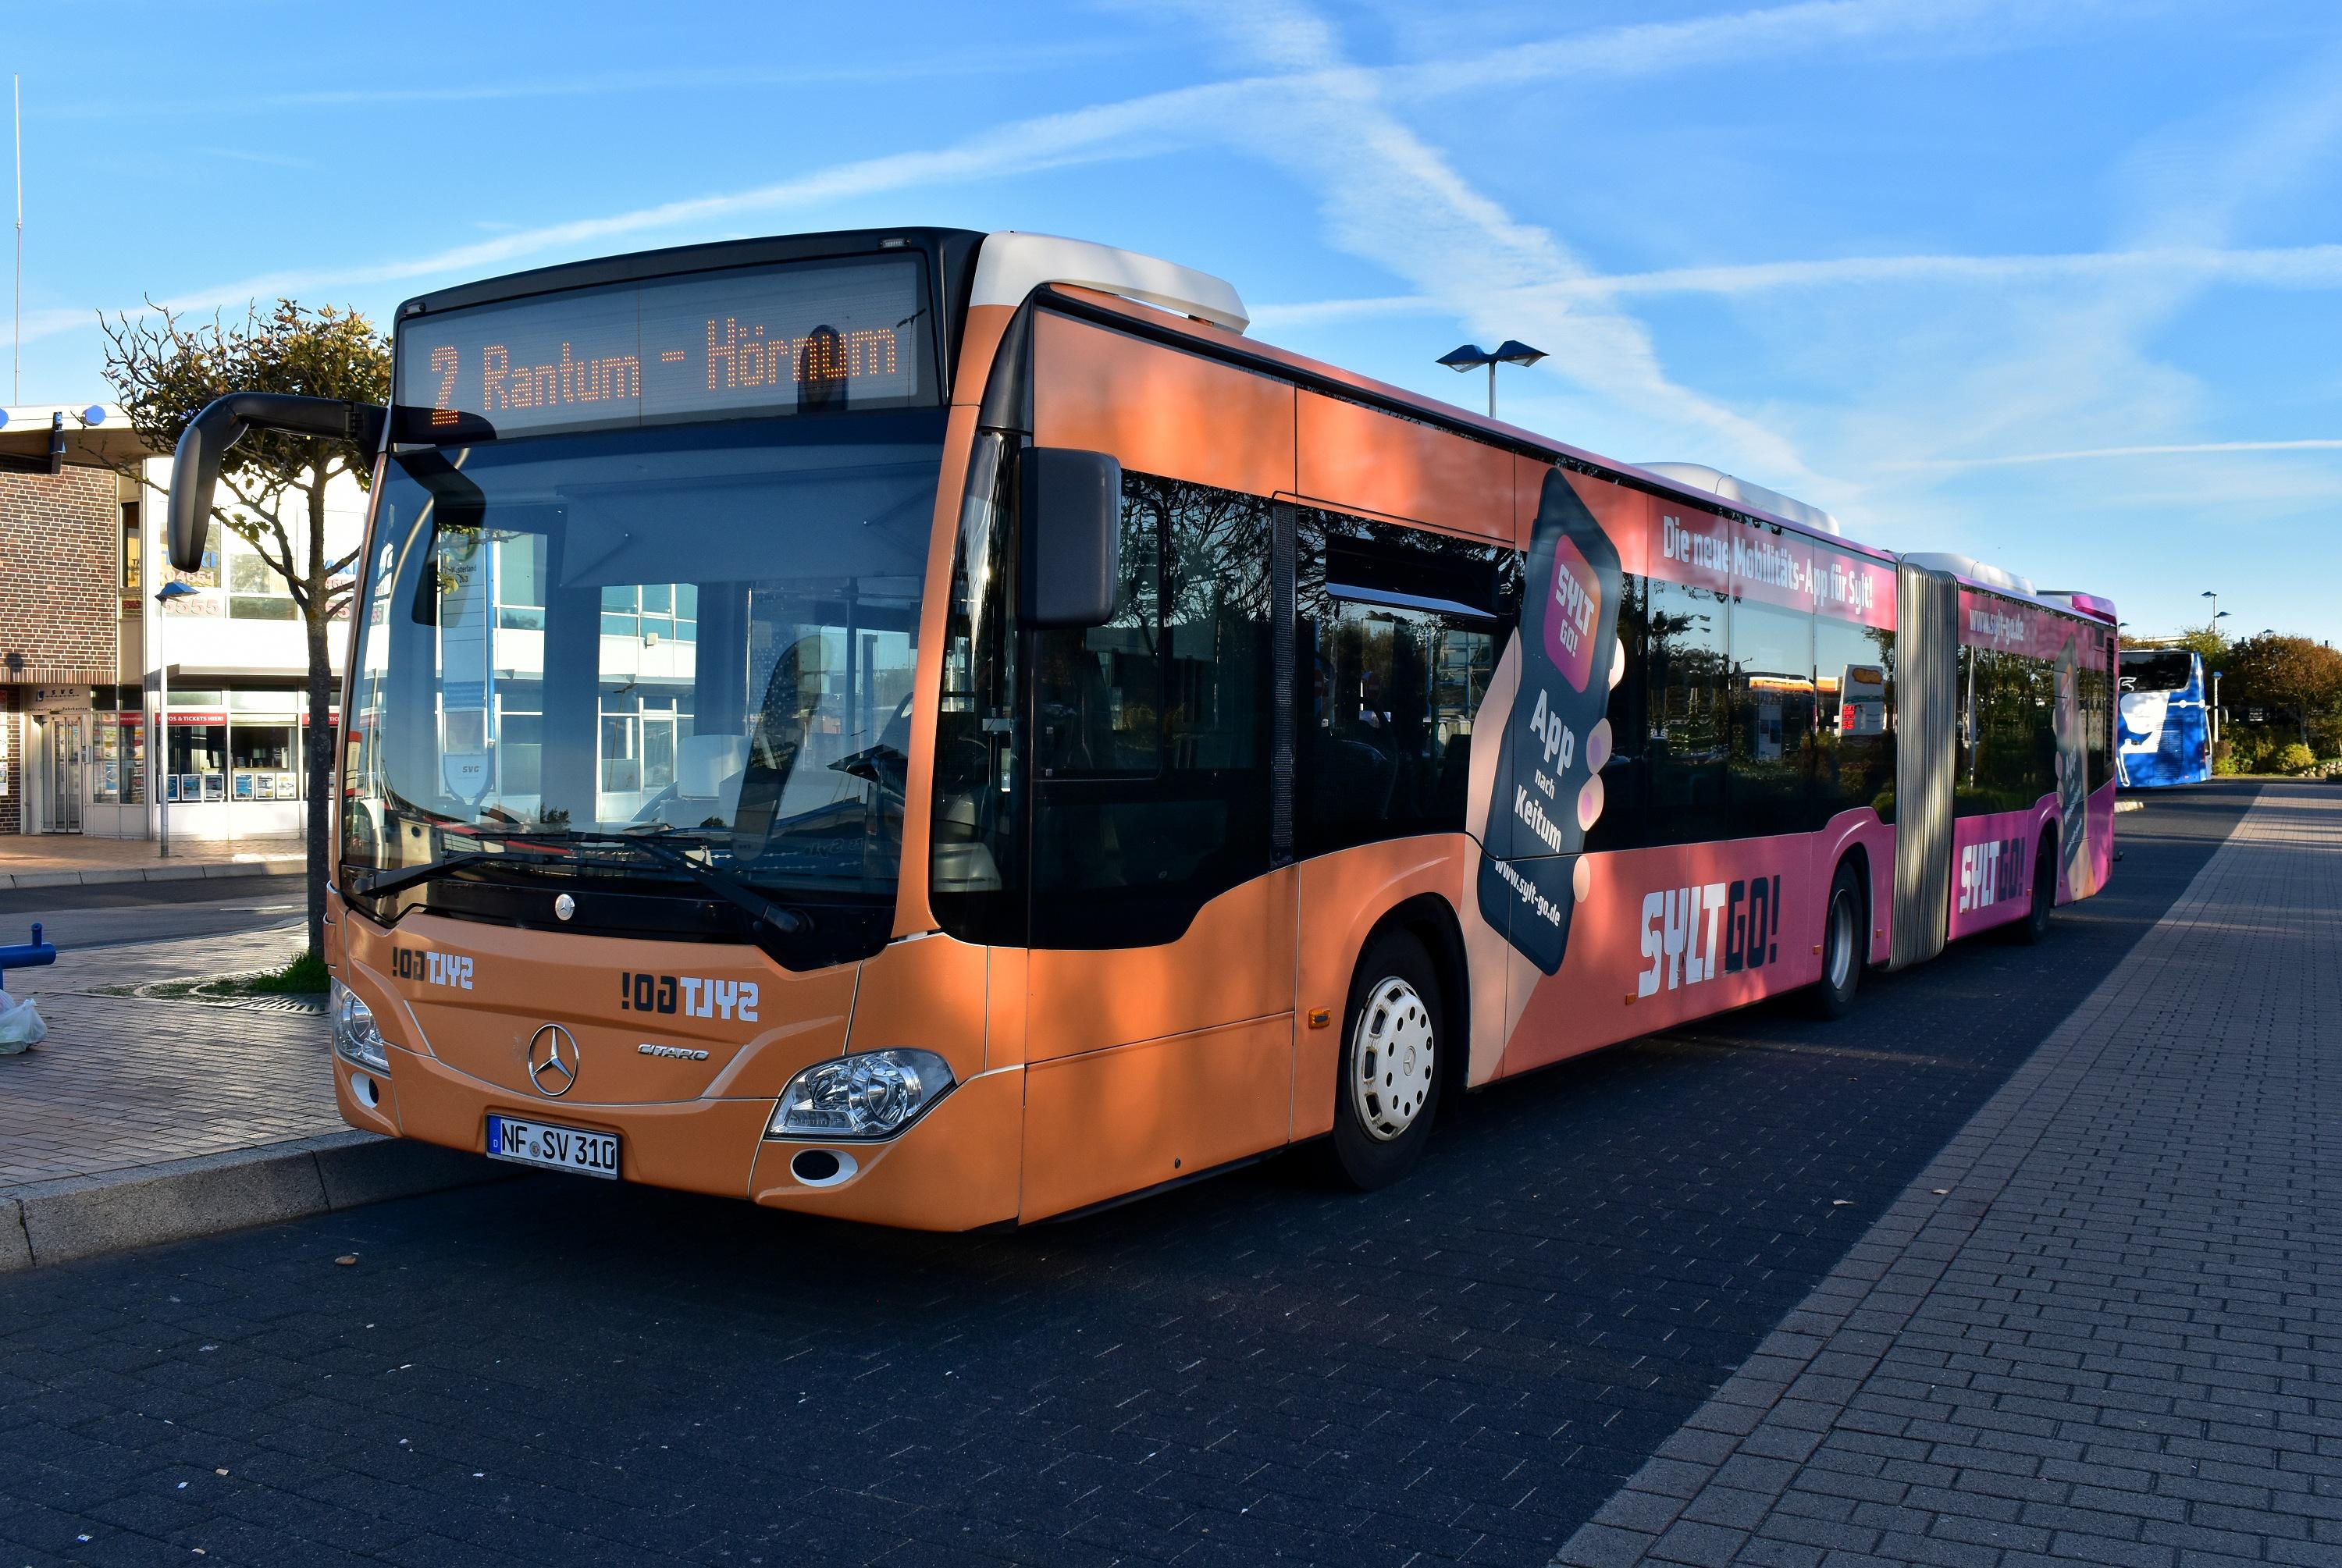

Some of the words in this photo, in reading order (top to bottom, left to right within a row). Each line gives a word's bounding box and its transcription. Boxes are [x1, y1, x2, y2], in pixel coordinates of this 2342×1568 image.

[430, 346, 458, 425] 2
[483, 342, 640, 411] Rantum
[707, 318, 896, 389] Hörnum
[1663, 515, 1689, 563] Die
[1693, 532, 1729, 573] neue
[1733, 536, 1828, 606] Mobilitäts-App
[1831, 563, 1847, 603] für
[1849, 570, 1874, 615] Sylt!
[1556, 564, 1594, 636] SYLT
[1560, 619, 1579, 658] GO!
[1970, 609, 2023, 645] www.sylt-go.de
[1529, 688, 1575, 777] App
[462, 765, 480, 773] SVG
[1535, 769, 1555, 799] nach
[1514, 784, 1561, 853] Keitum
[1495, 855, 1561, 927] www.sylt-go.de
[637, 1044, 710, 1061] CITARO
[493, 1140, 499, 1148] D
[502, 1122, 528, 1153] NF
[543, 1130, 569, 1161] SV
[575, 1135, 615, 1170] 310
